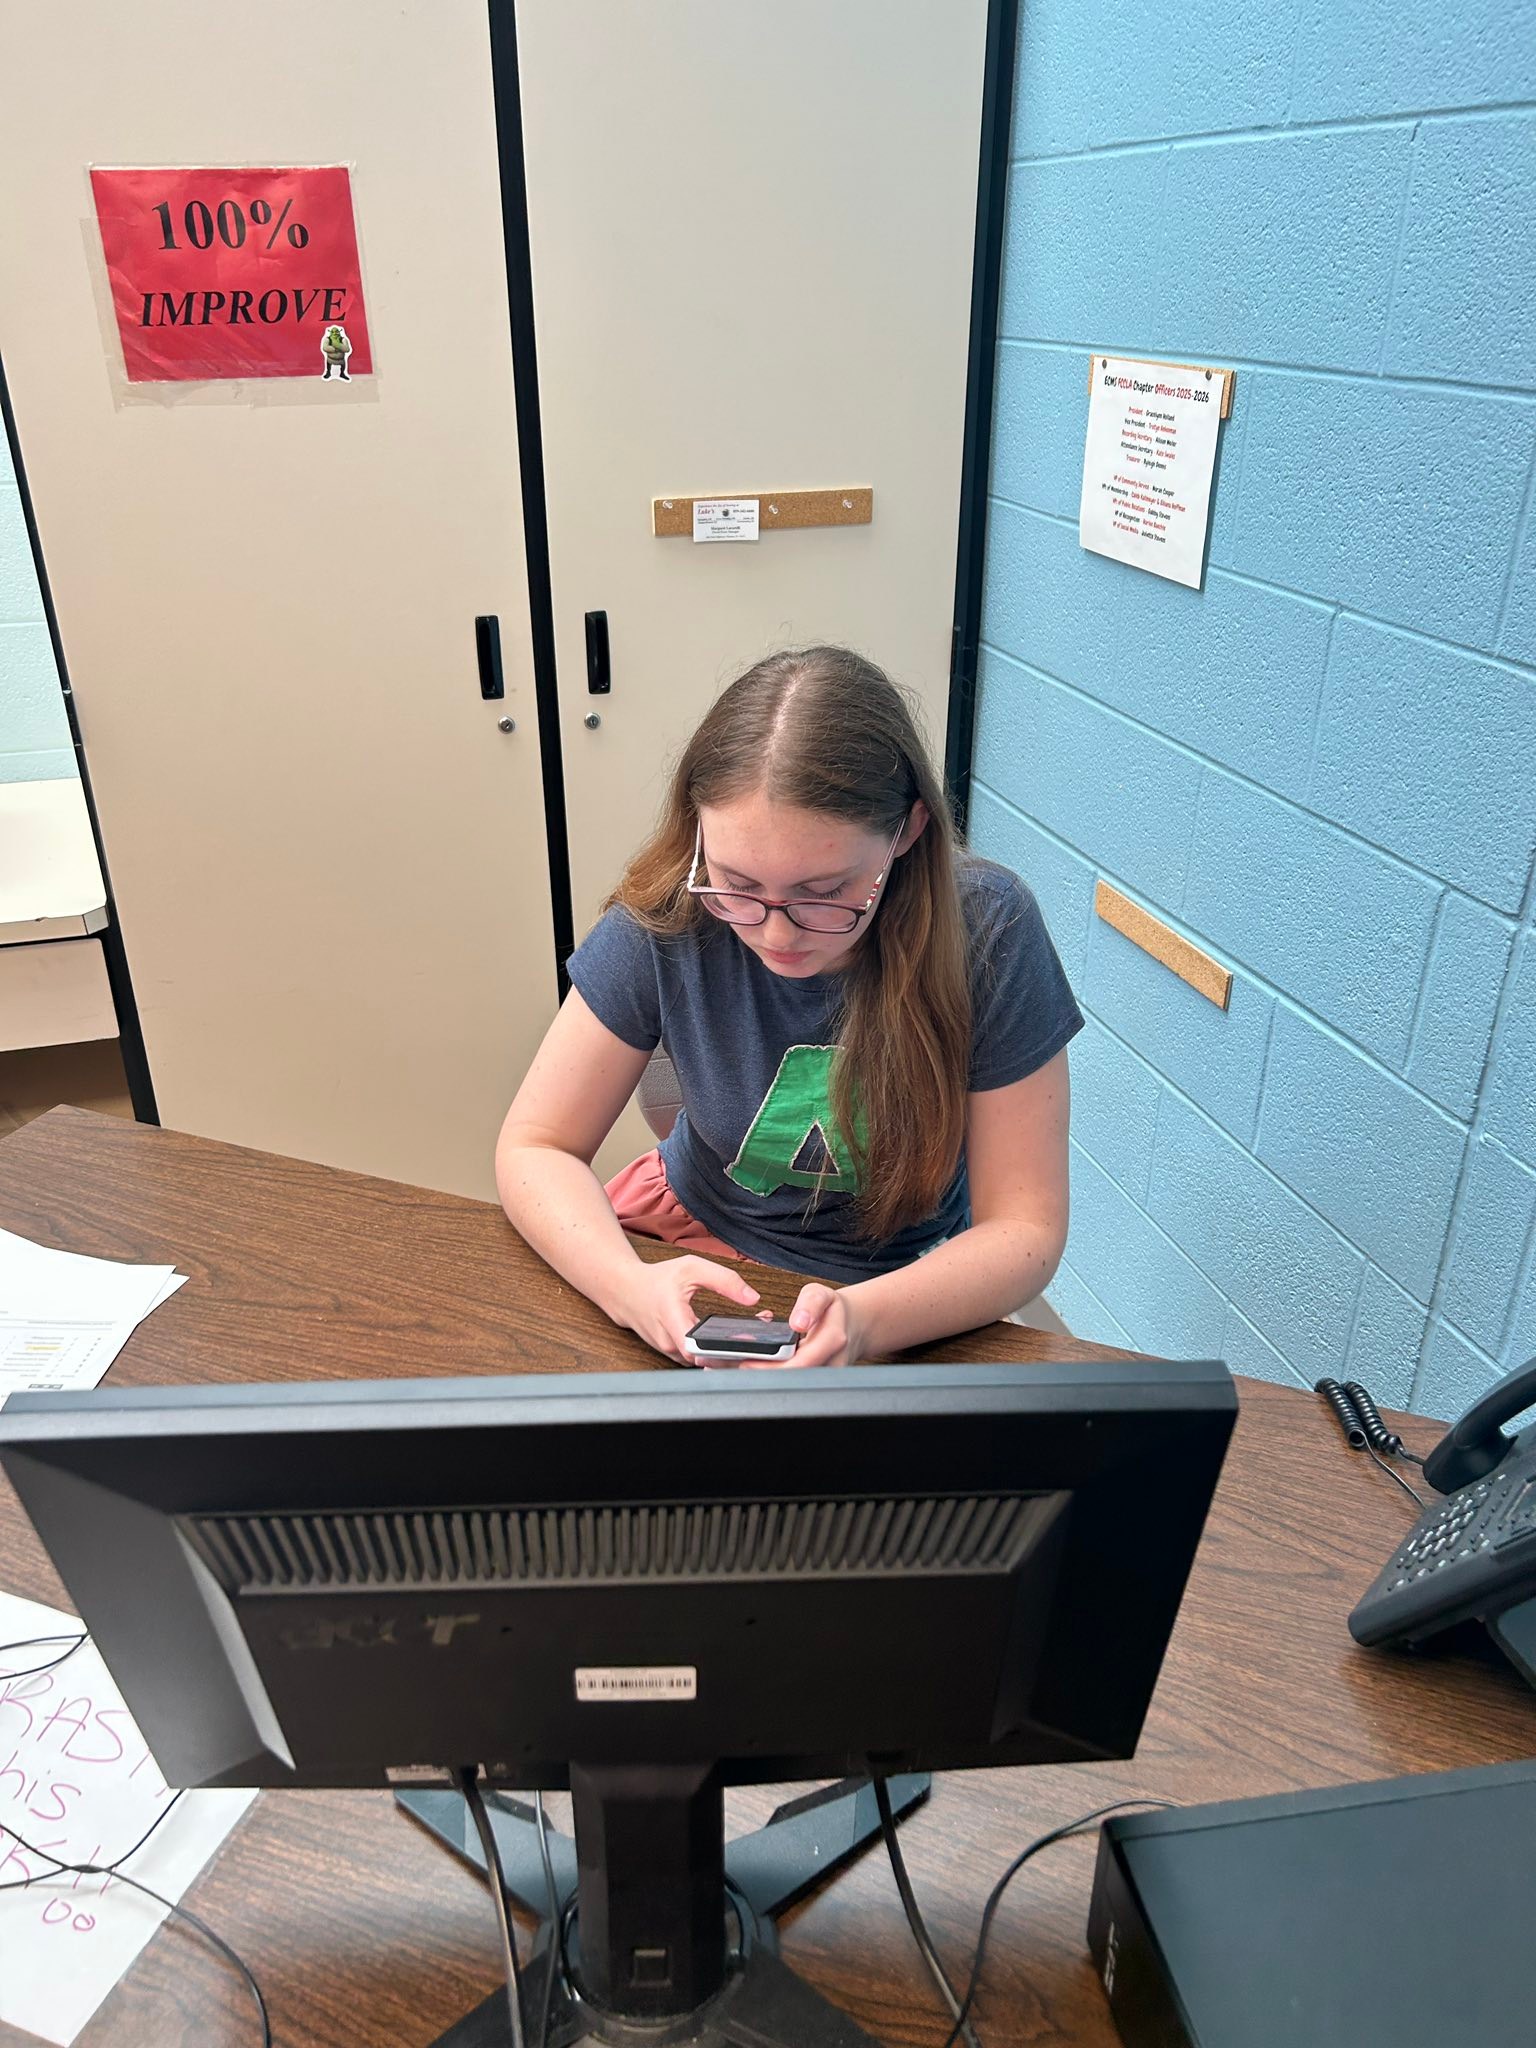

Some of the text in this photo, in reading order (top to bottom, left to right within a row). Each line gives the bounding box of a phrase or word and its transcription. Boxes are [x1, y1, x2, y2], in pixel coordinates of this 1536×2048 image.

[152, 199, 309, 250] 100%
[139, 288, 347, 327] IMPROVE
[1118, 377, 1132, 390] FCCLA
[1133, 380, 1154, 396] Chapter
[1155, 383, 1176, 397] Officers
[1176, 387, 1209, 403] 2025-2026
[723, 1044, 872, 1198] A
[0, 1669, 168, 1798] RAS
